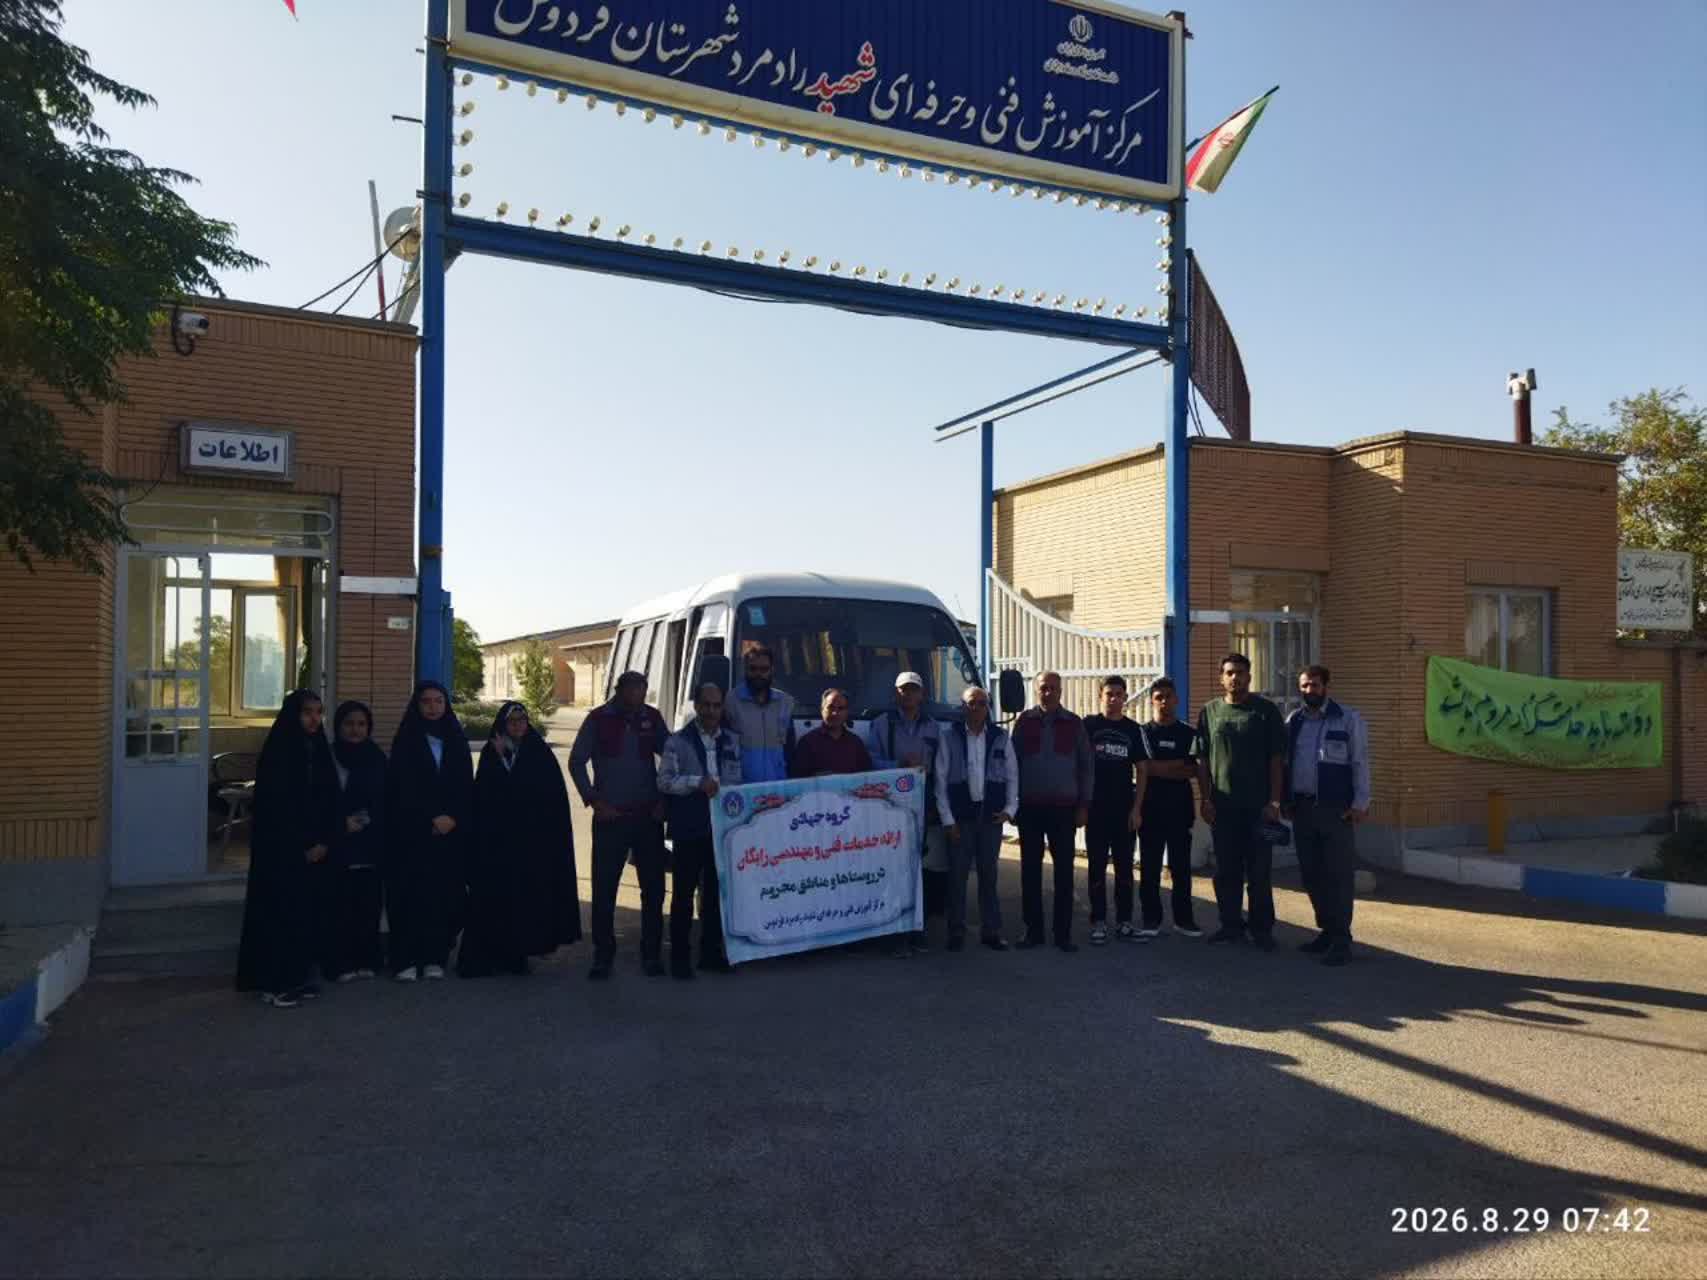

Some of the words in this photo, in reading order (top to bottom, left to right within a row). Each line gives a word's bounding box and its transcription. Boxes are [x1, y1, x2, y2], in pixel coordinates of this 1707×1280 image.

[610, 3, 740, 76] شهرستان
[727, 48, 807, 91] رادمرد
[803, 41, 878, 117] شهید
[961, 106, 977, 129] و
[980, 76, 1019, 145] فنی
[1015, 92, 1111, 154] آموزش
[1103, 87, 1161, 165] مرکز
[198, 439, 279, 464] اطلاعات
[789, 811, 825, 831] جهادی
[825, 805, 851, 826] گروه
[821, 834, 842, 861] فنی
[843, 834, 879, 851] خدمات
[736, 846, 769, 871] رایگان
[768, 845, 815, 867] مهندسی
[759, 882, 797, 900] محروم
[797, 875, 830, 895] مناطق
[836, 871, 874, 886] روستاها
